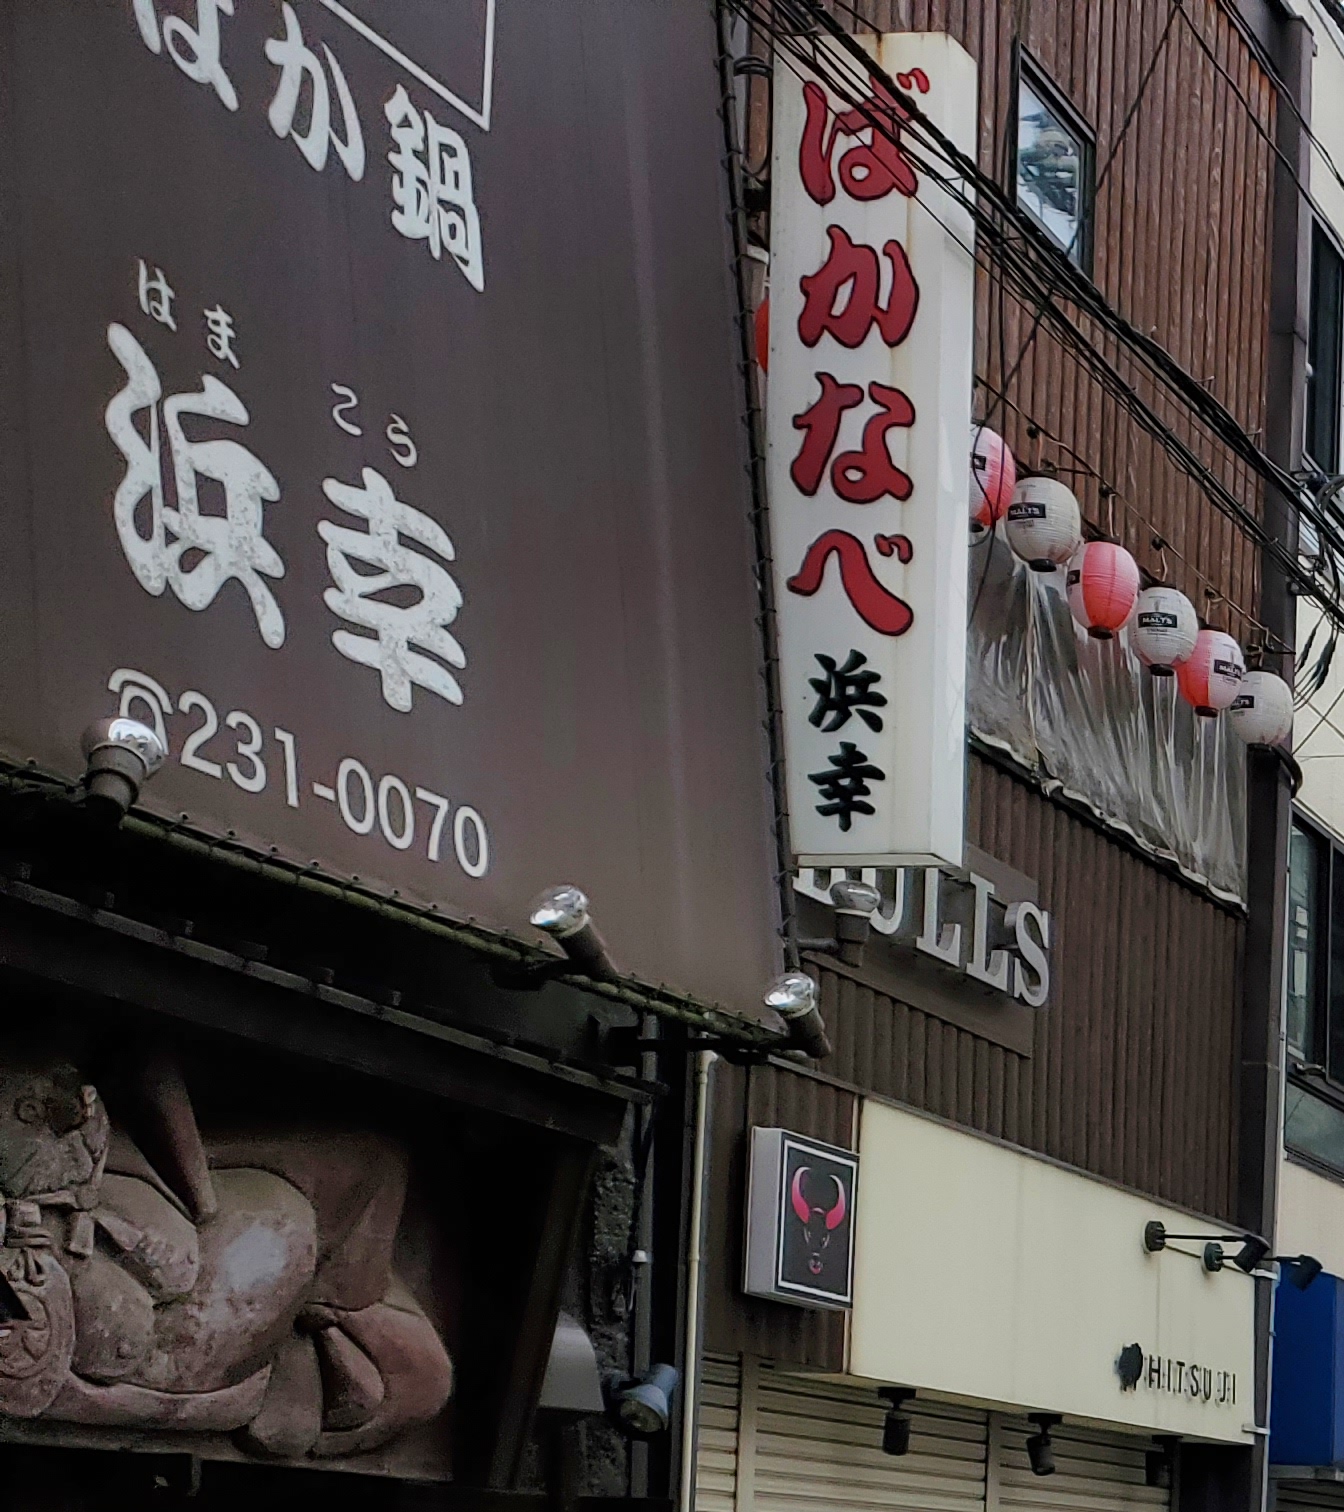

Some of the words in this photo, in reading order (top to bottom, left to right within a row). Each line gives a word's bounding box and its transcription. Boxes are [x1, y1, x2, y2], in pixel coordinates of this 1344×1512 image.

[137, 257, 240, 369] はま
[330, 382, 419, 468] こう
[787, 66, 932, 639] ばかなべ
[105, 322, 467, 712] 浜幸
[180, 690, 490, 880] 231-0070
[806, 649, 888, 833] 浜幸
[1148, 1353, 1237, 1407] HITSUJI
